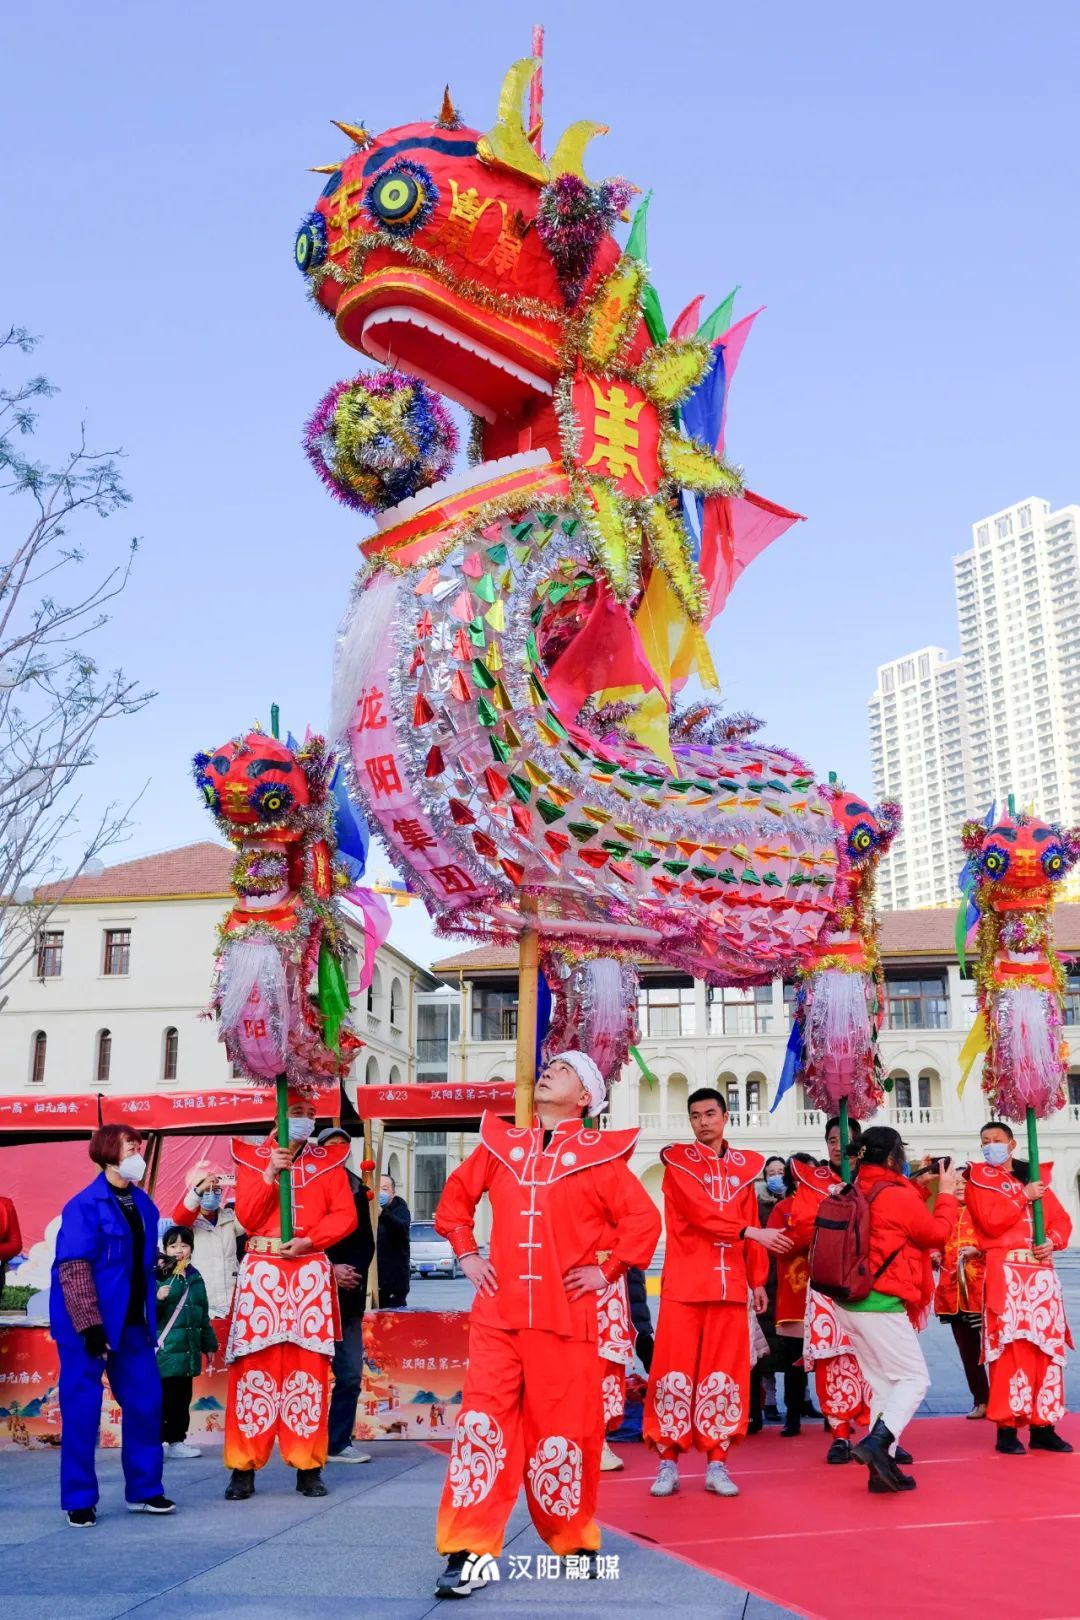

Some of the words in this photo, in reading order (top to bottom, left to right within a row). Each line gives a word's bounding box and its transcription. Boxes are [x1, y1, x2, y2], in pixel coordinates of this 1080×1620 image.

[356, 686, 477, 895] 龙阳集团
[430, 1088, 516, 1101] 汉阳区第二十一
